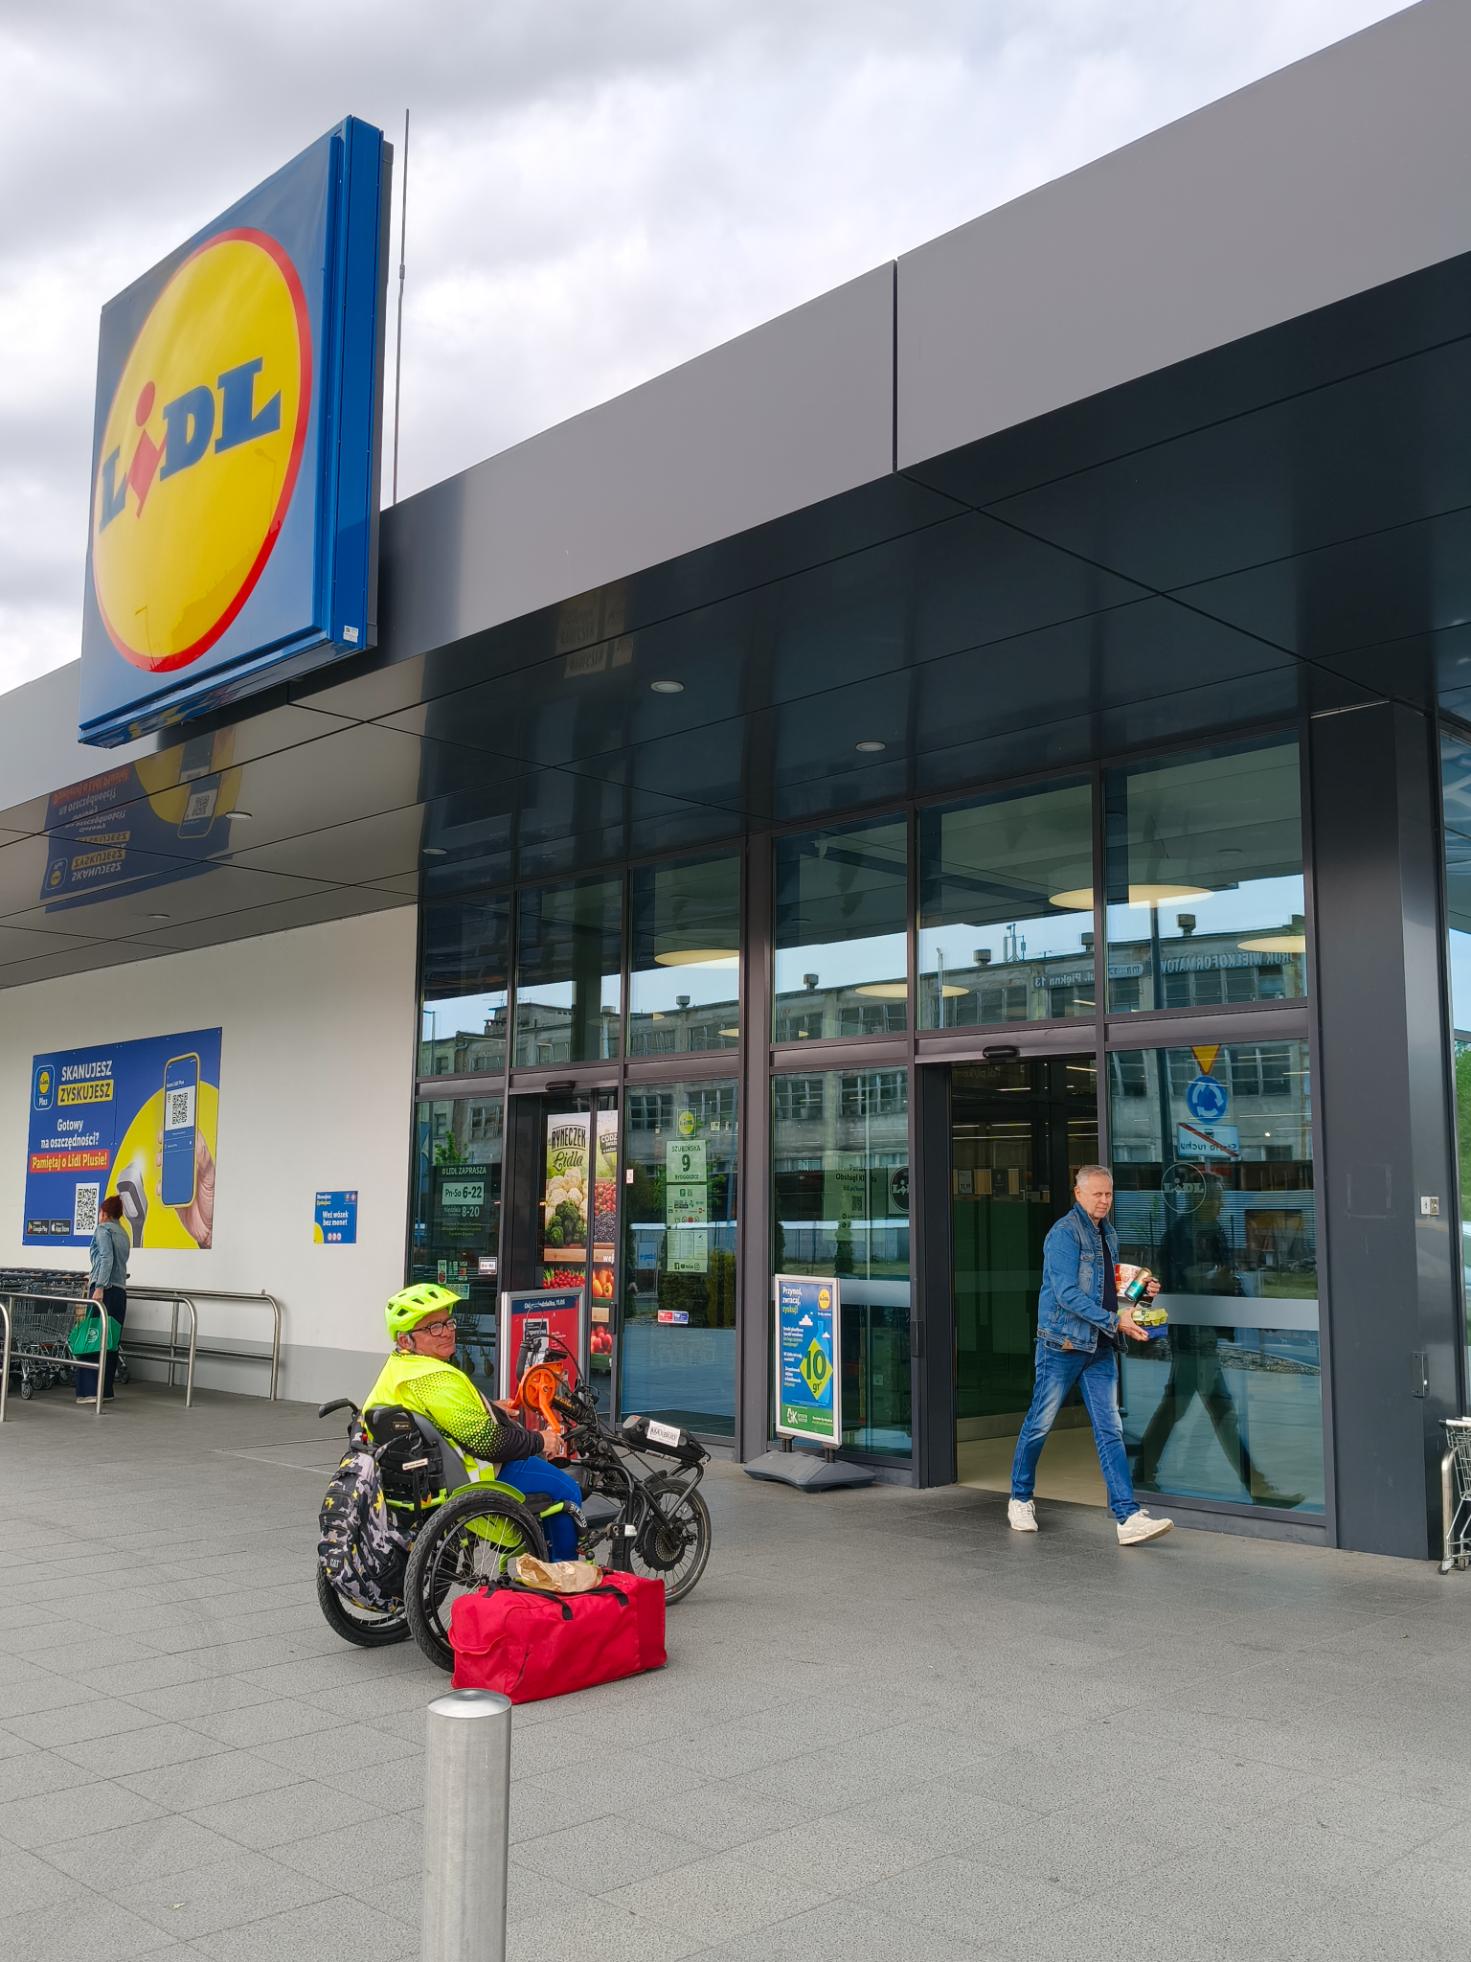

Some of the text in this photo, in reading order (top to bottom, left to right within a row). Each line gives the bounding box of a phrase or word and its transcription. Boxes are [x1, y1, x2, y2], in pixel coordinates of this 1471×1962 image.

[61, 1060, 113, 1081] SKANUJESZ
[60, 1082, 111, 1103] ZYSKUJESZ
[57, 1118, 84, 1132] Gotowy
[41, 1138, 50, 1149] na
[552, 1127, 586, 1149] RYNECZEK
[67, 1152, 81, 1167] Lidl
[553, 1151, 584, 1171] Lidla
[681, 1153, 691, 1172] 9
[462, 1185, 483, 1199] 6-22
[462, 1206, 480, 1217] 8-20
[803, 1348, 827, 1381] 10
